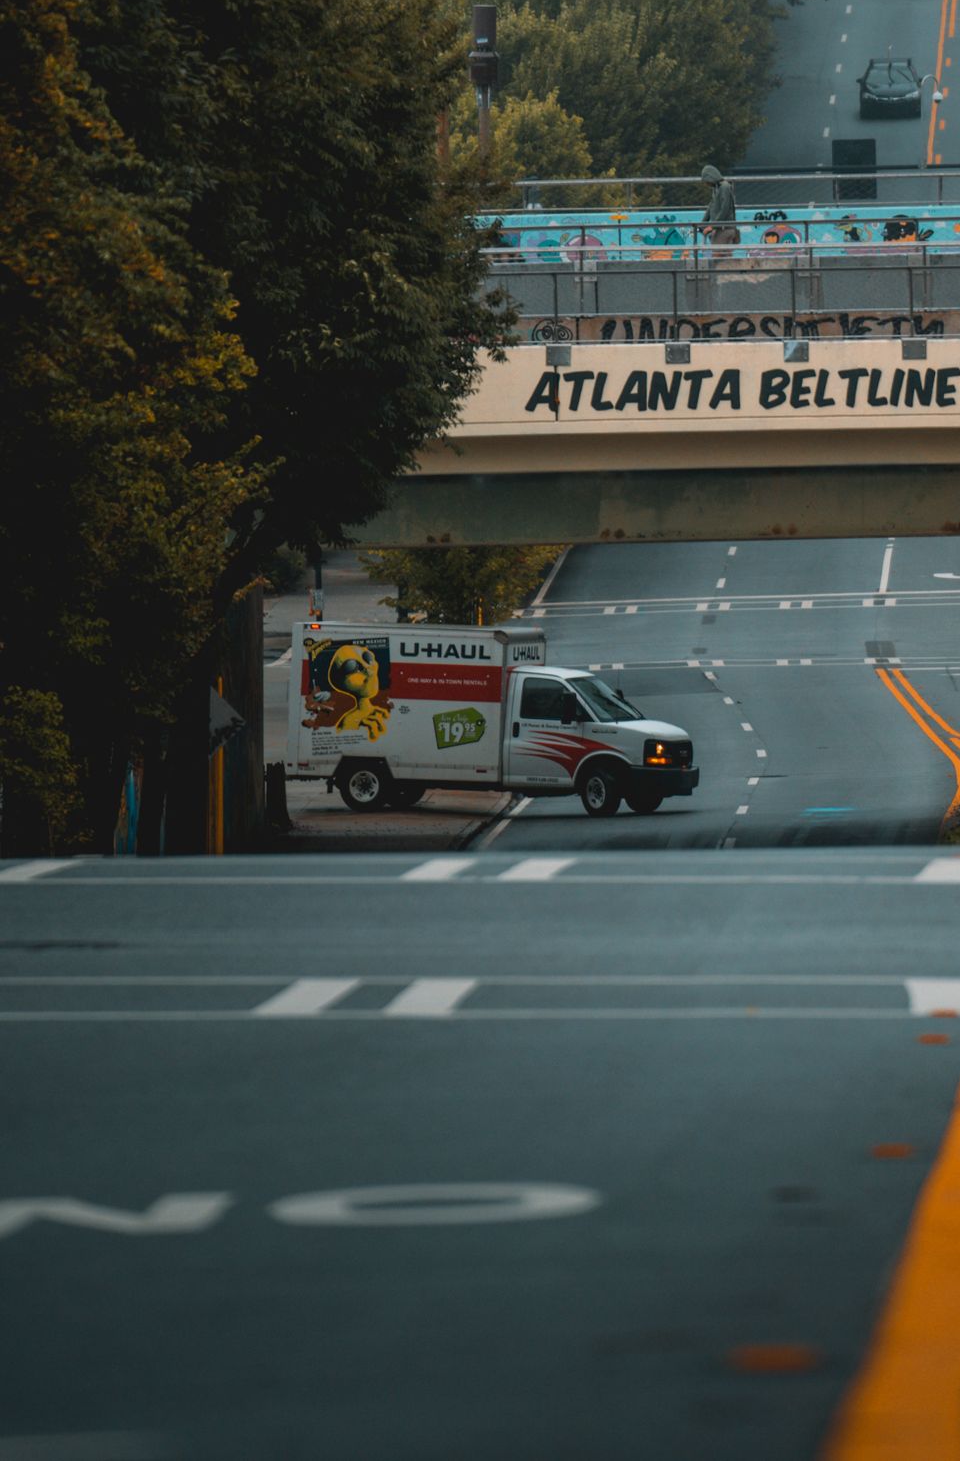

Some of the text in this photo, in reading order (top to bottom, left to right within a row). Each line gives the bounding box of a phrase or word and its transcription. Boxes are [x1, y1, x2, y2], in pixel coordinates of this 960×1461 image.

[525, 368, 741, 411] ATLANTA
[400, 642, 491, 660] U-HAUL
[513, 646, 540, 661] U-HAUL
